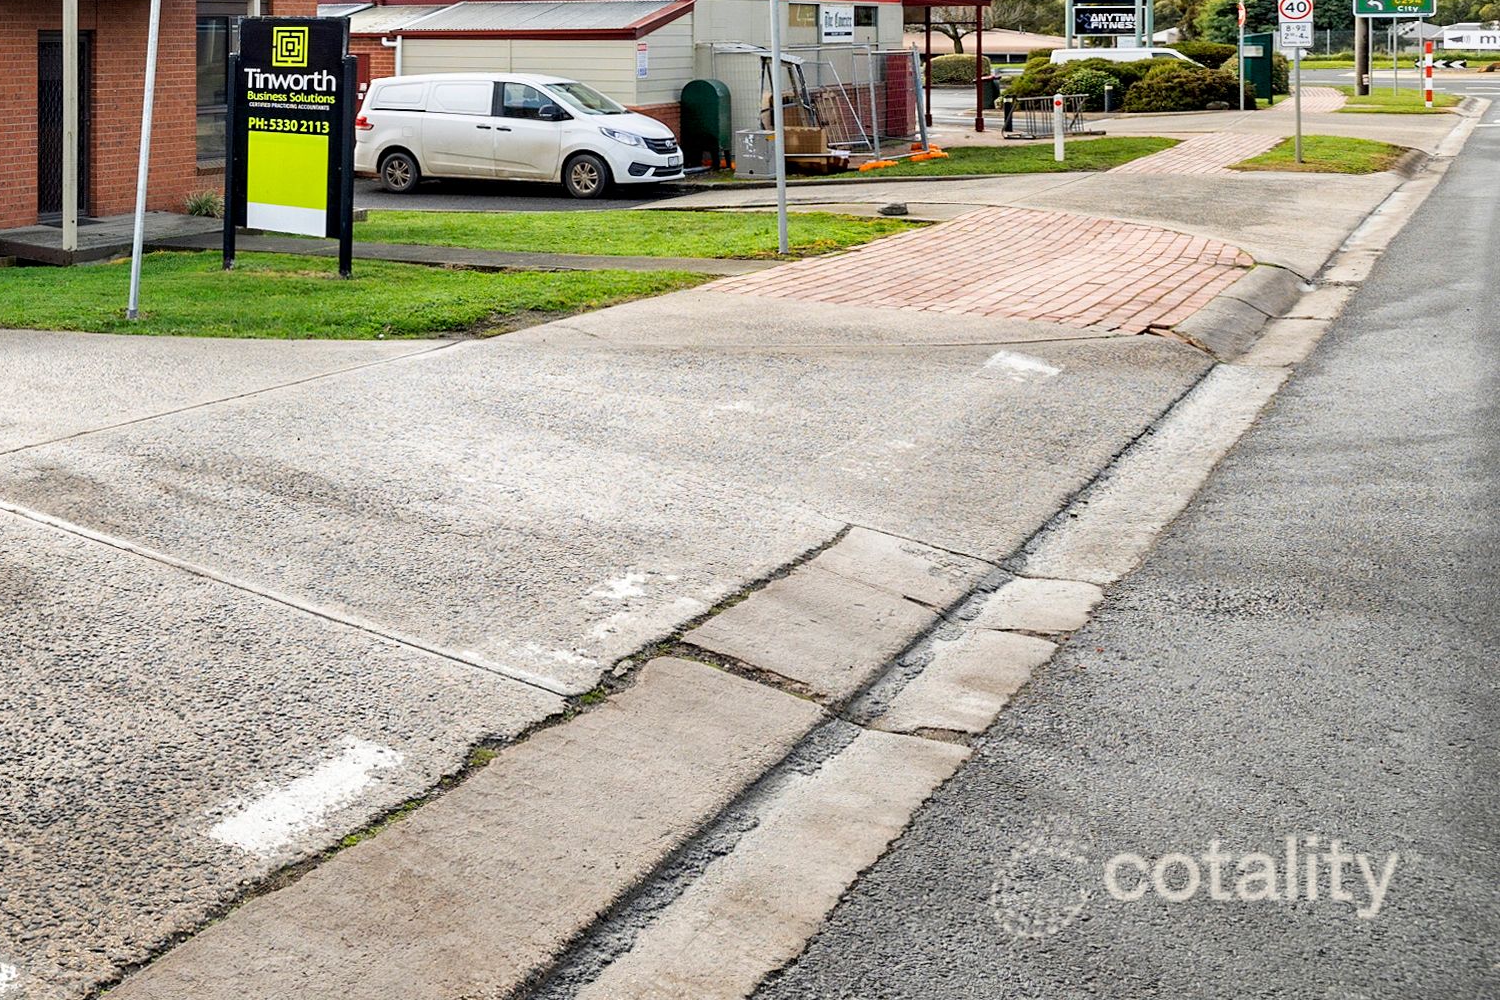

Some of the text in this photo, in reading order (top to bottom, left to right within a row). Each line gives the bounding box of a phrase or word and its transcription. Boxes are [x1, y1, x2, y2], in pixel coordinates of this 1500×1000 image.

[1285, 1, 1307, 13] 40
[1397, 5, 1419, 13] City
[1090, 13, 1141, 22] ANYTIM
[1480, 35, 1500, 46] m
[244, 68, 336, 92] Tinworth
[247, 91, 336, 104] Business Solutions
[248, 116, 330, 133] PH: 5330 2113
